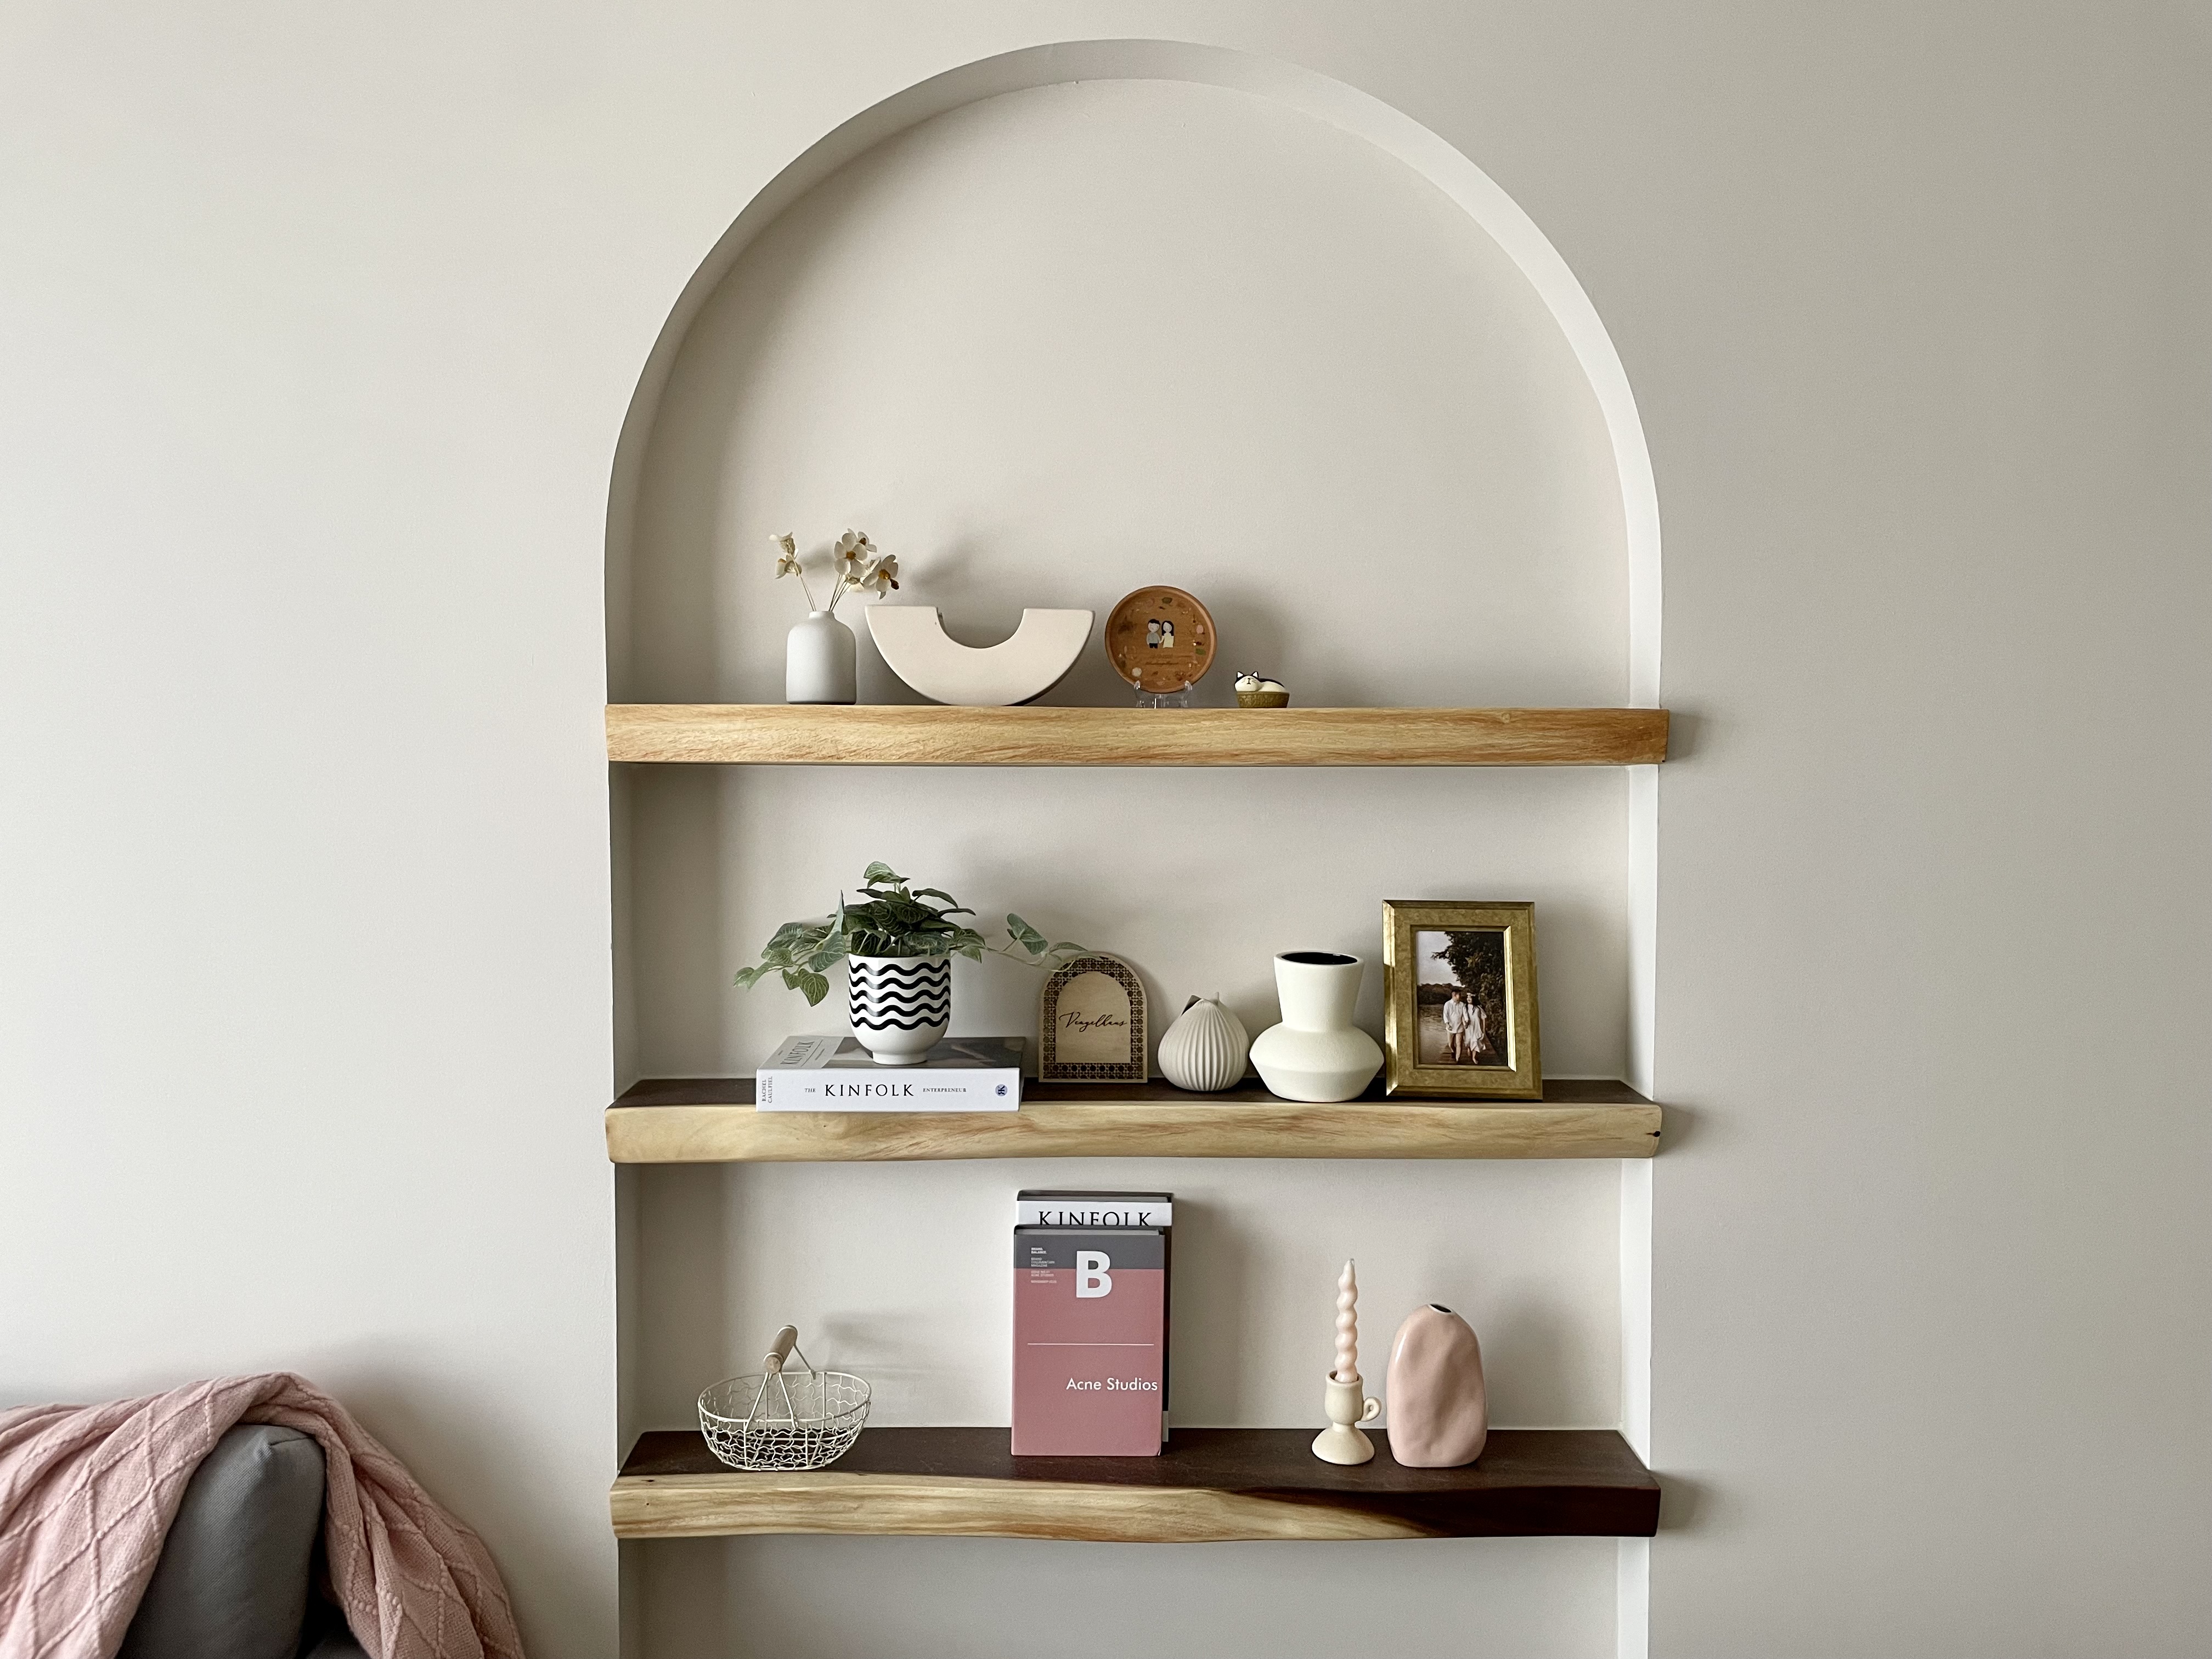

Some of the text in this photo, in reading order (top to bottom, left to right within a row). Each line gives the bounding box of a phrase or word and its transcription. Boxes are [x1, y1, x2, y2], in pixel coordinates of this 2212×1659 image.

[780, 1041, 815, 1065] KINFOLK
[825, 1084, 914, 1096] KINFOLK
[1076, 1251, 1112, 1298] B
[1066, 1377, 1158, 1391] Acne Studios
